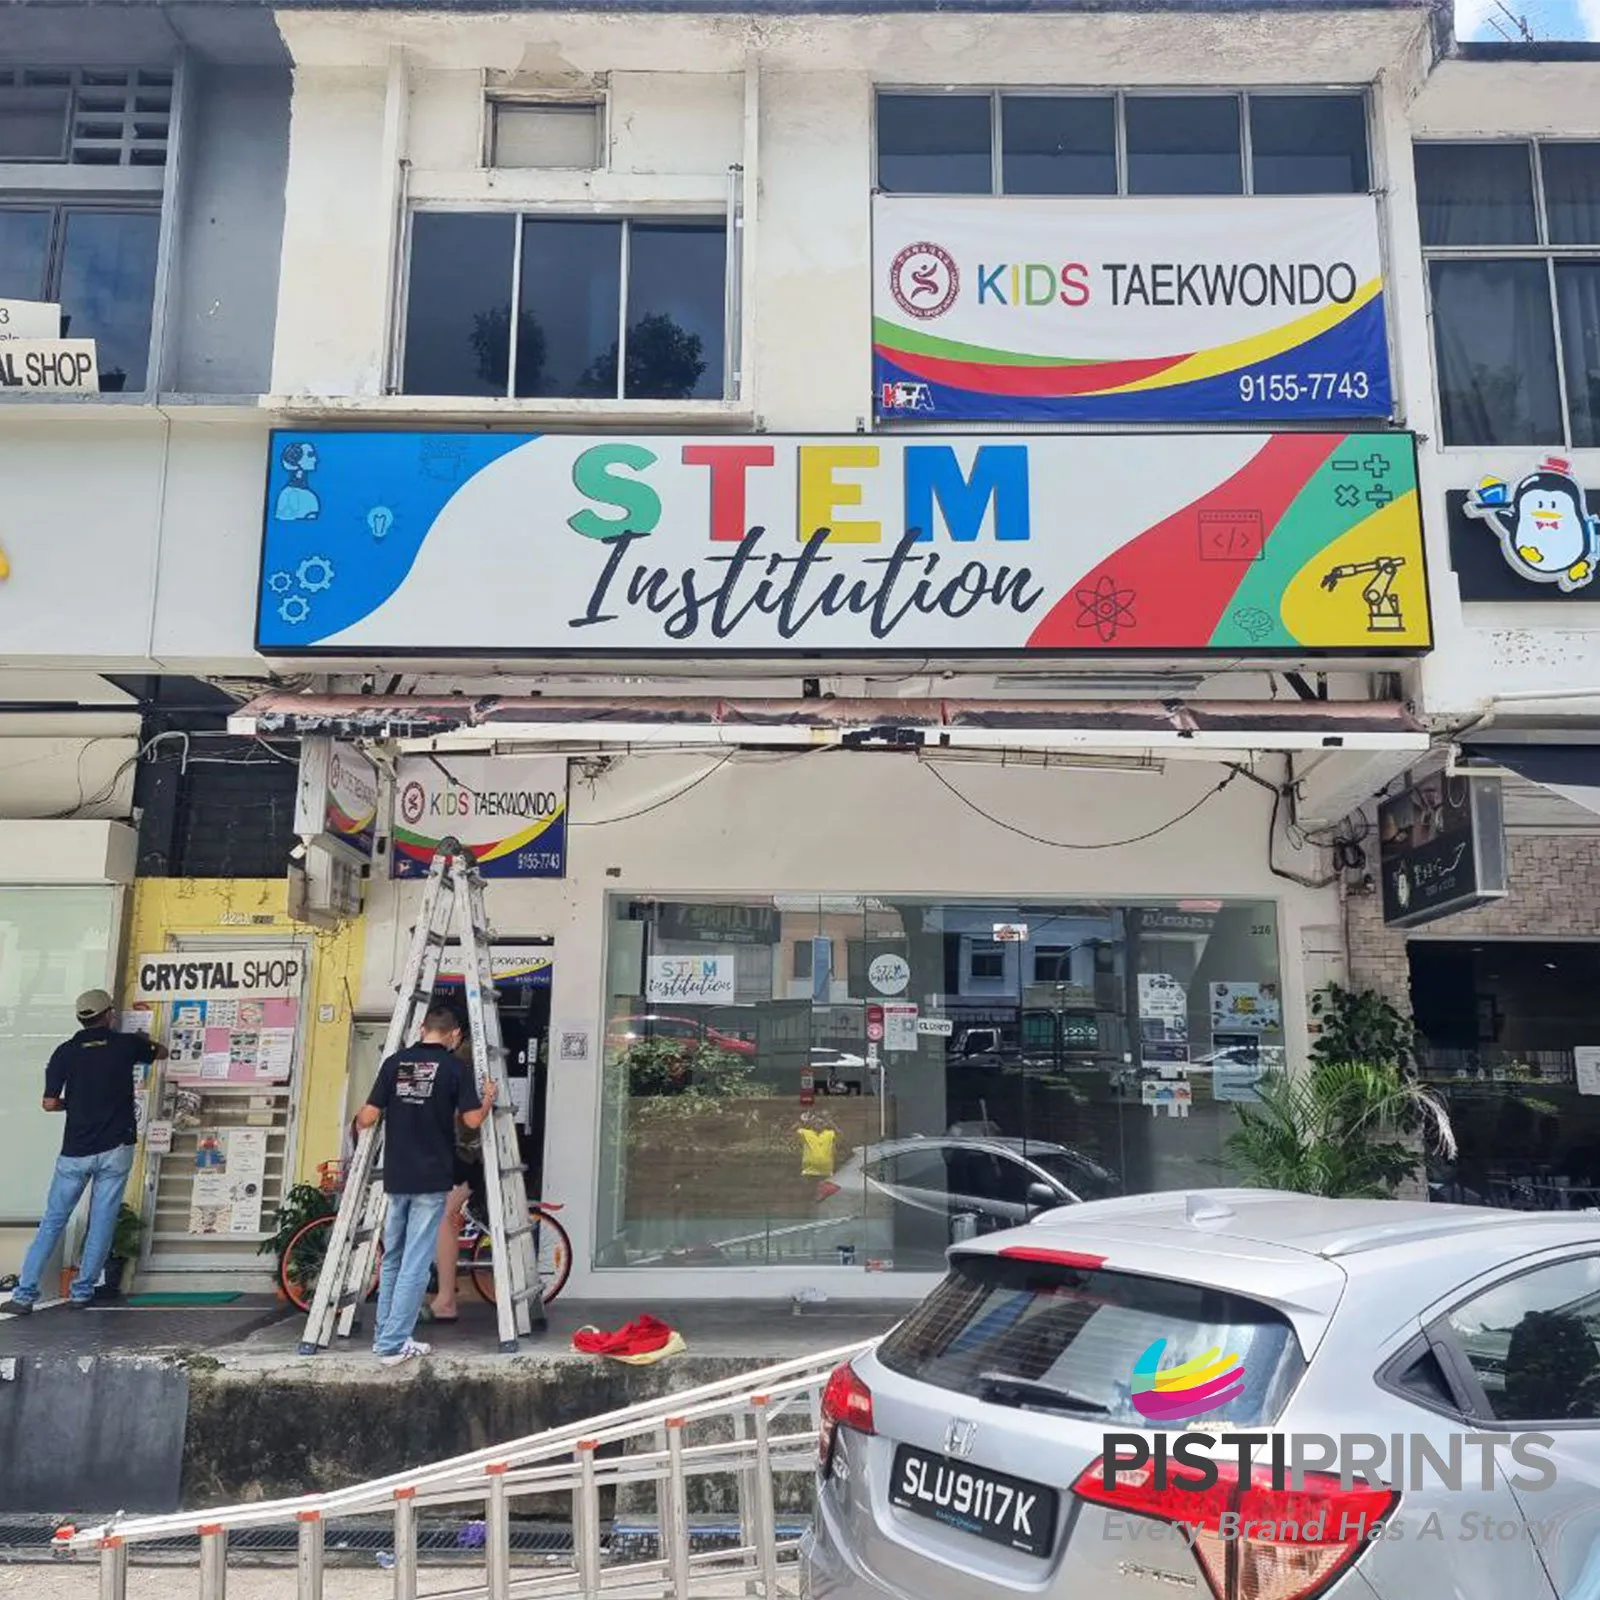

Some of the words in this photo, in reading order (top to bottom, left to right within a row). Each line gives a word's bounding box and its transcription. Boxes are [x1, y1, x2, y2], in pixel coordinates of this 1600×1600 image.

[977, 262, 1090, 307] KIDS
[1103, 261, 1357, 306] TAEKWONDO
[25, 352, 92, 386] SHOP
[1239, 371, 1370, 402] 9155-7743
[567, 443, 1031, 543] STEM
[568, 526, 1045, 640] Institution
[429, 791, 470, 816] KIDS
[473, 791, 558, 816] TAEKWONDO
[518, 852, 561, 870] 9155-7743
[140, 962, 239, 992] CRYSTAL
[241, 960, 299, 988] SHOP
[661, 959, 718, 978] STEM
[902, 1457, 1037, 1536] SLU9117K
